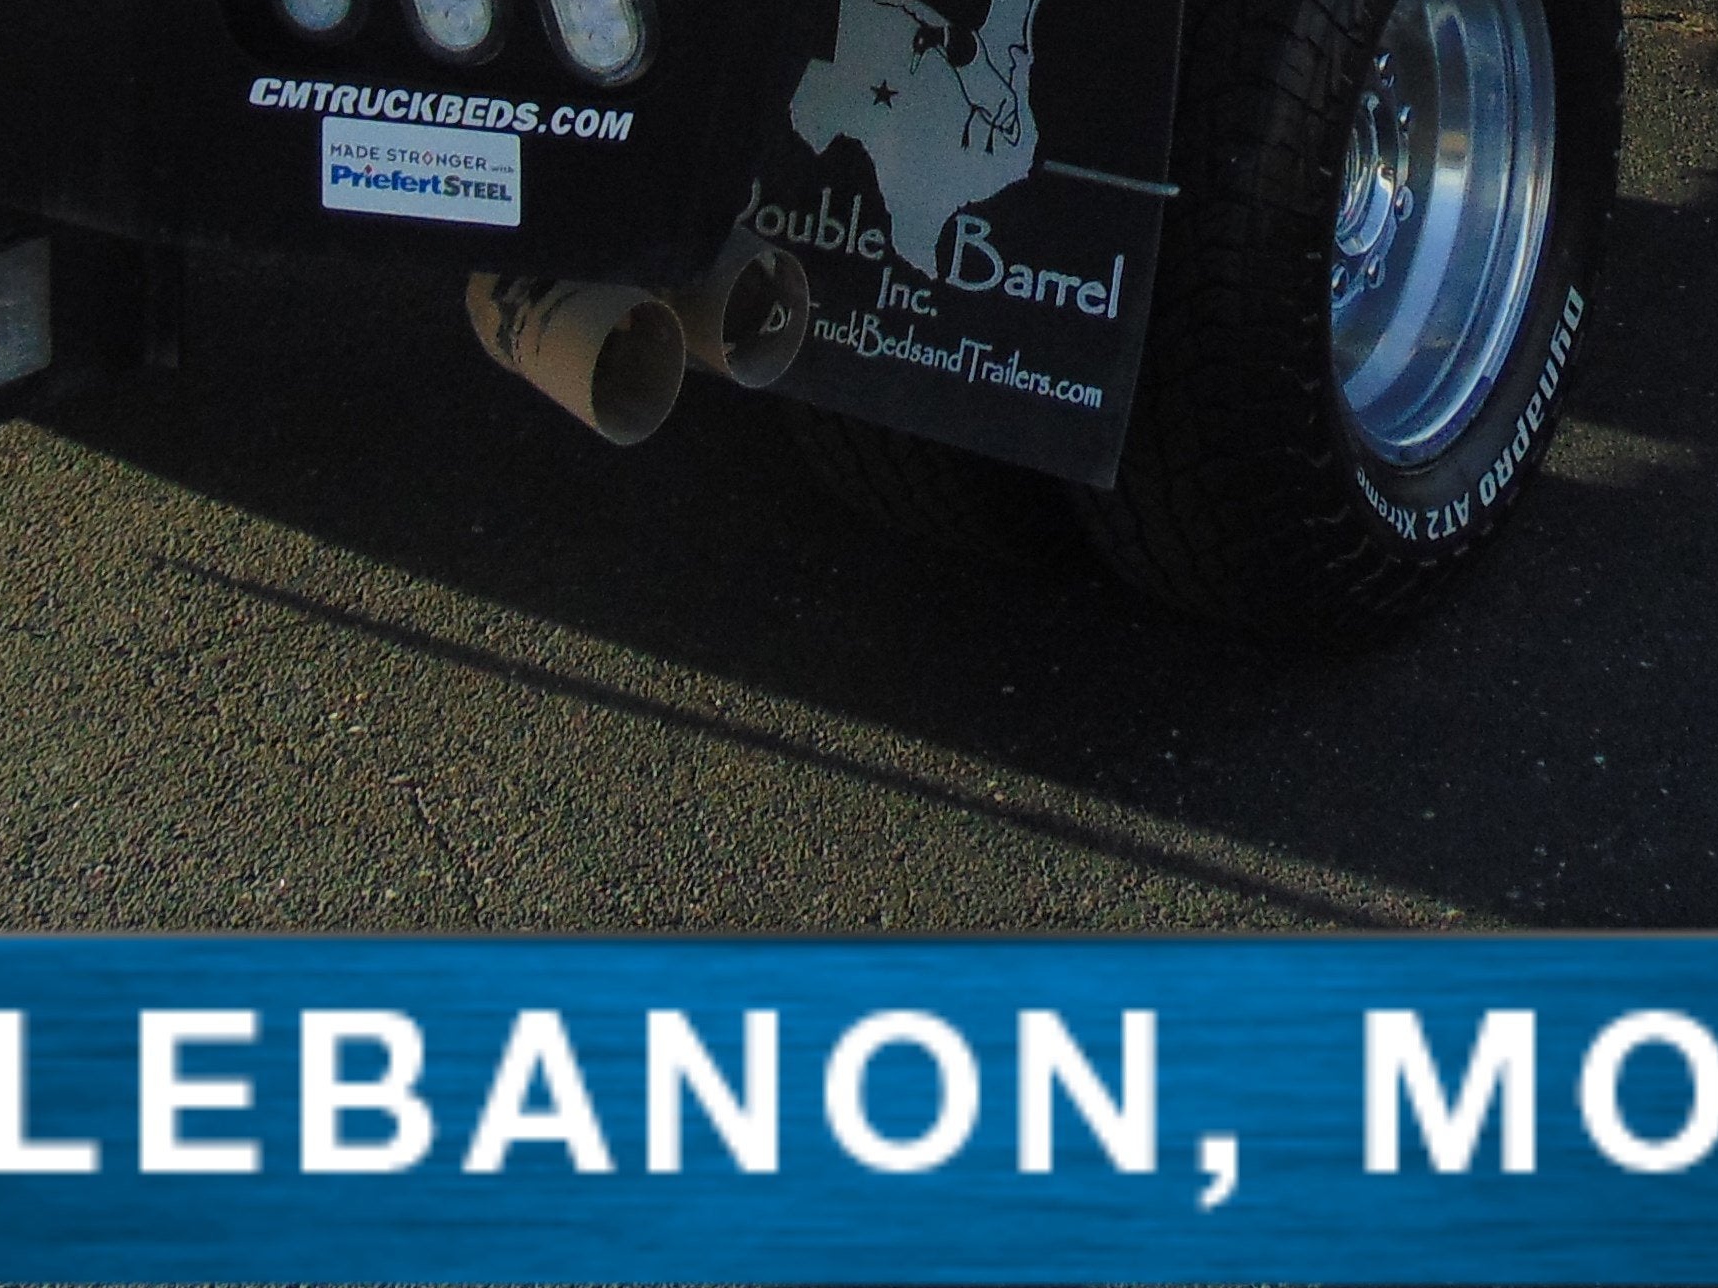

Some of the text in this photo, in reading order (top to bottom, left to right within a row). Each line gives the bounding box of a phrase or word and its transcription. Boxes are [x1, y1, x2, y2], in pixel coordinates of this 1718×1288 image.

[248, 76, 635, 142] CMTRUCKBEDS.COM
[329, 143, 381, 162] MADE
[386, 147, 488, 172] STRONGER
[876, 266, 939, 317] Inc.
[945, 213, 1125, 320] Barrel
[1356, 466, 1418, 542] Xtreme
[1425, 491, 1471, 541] AT2
